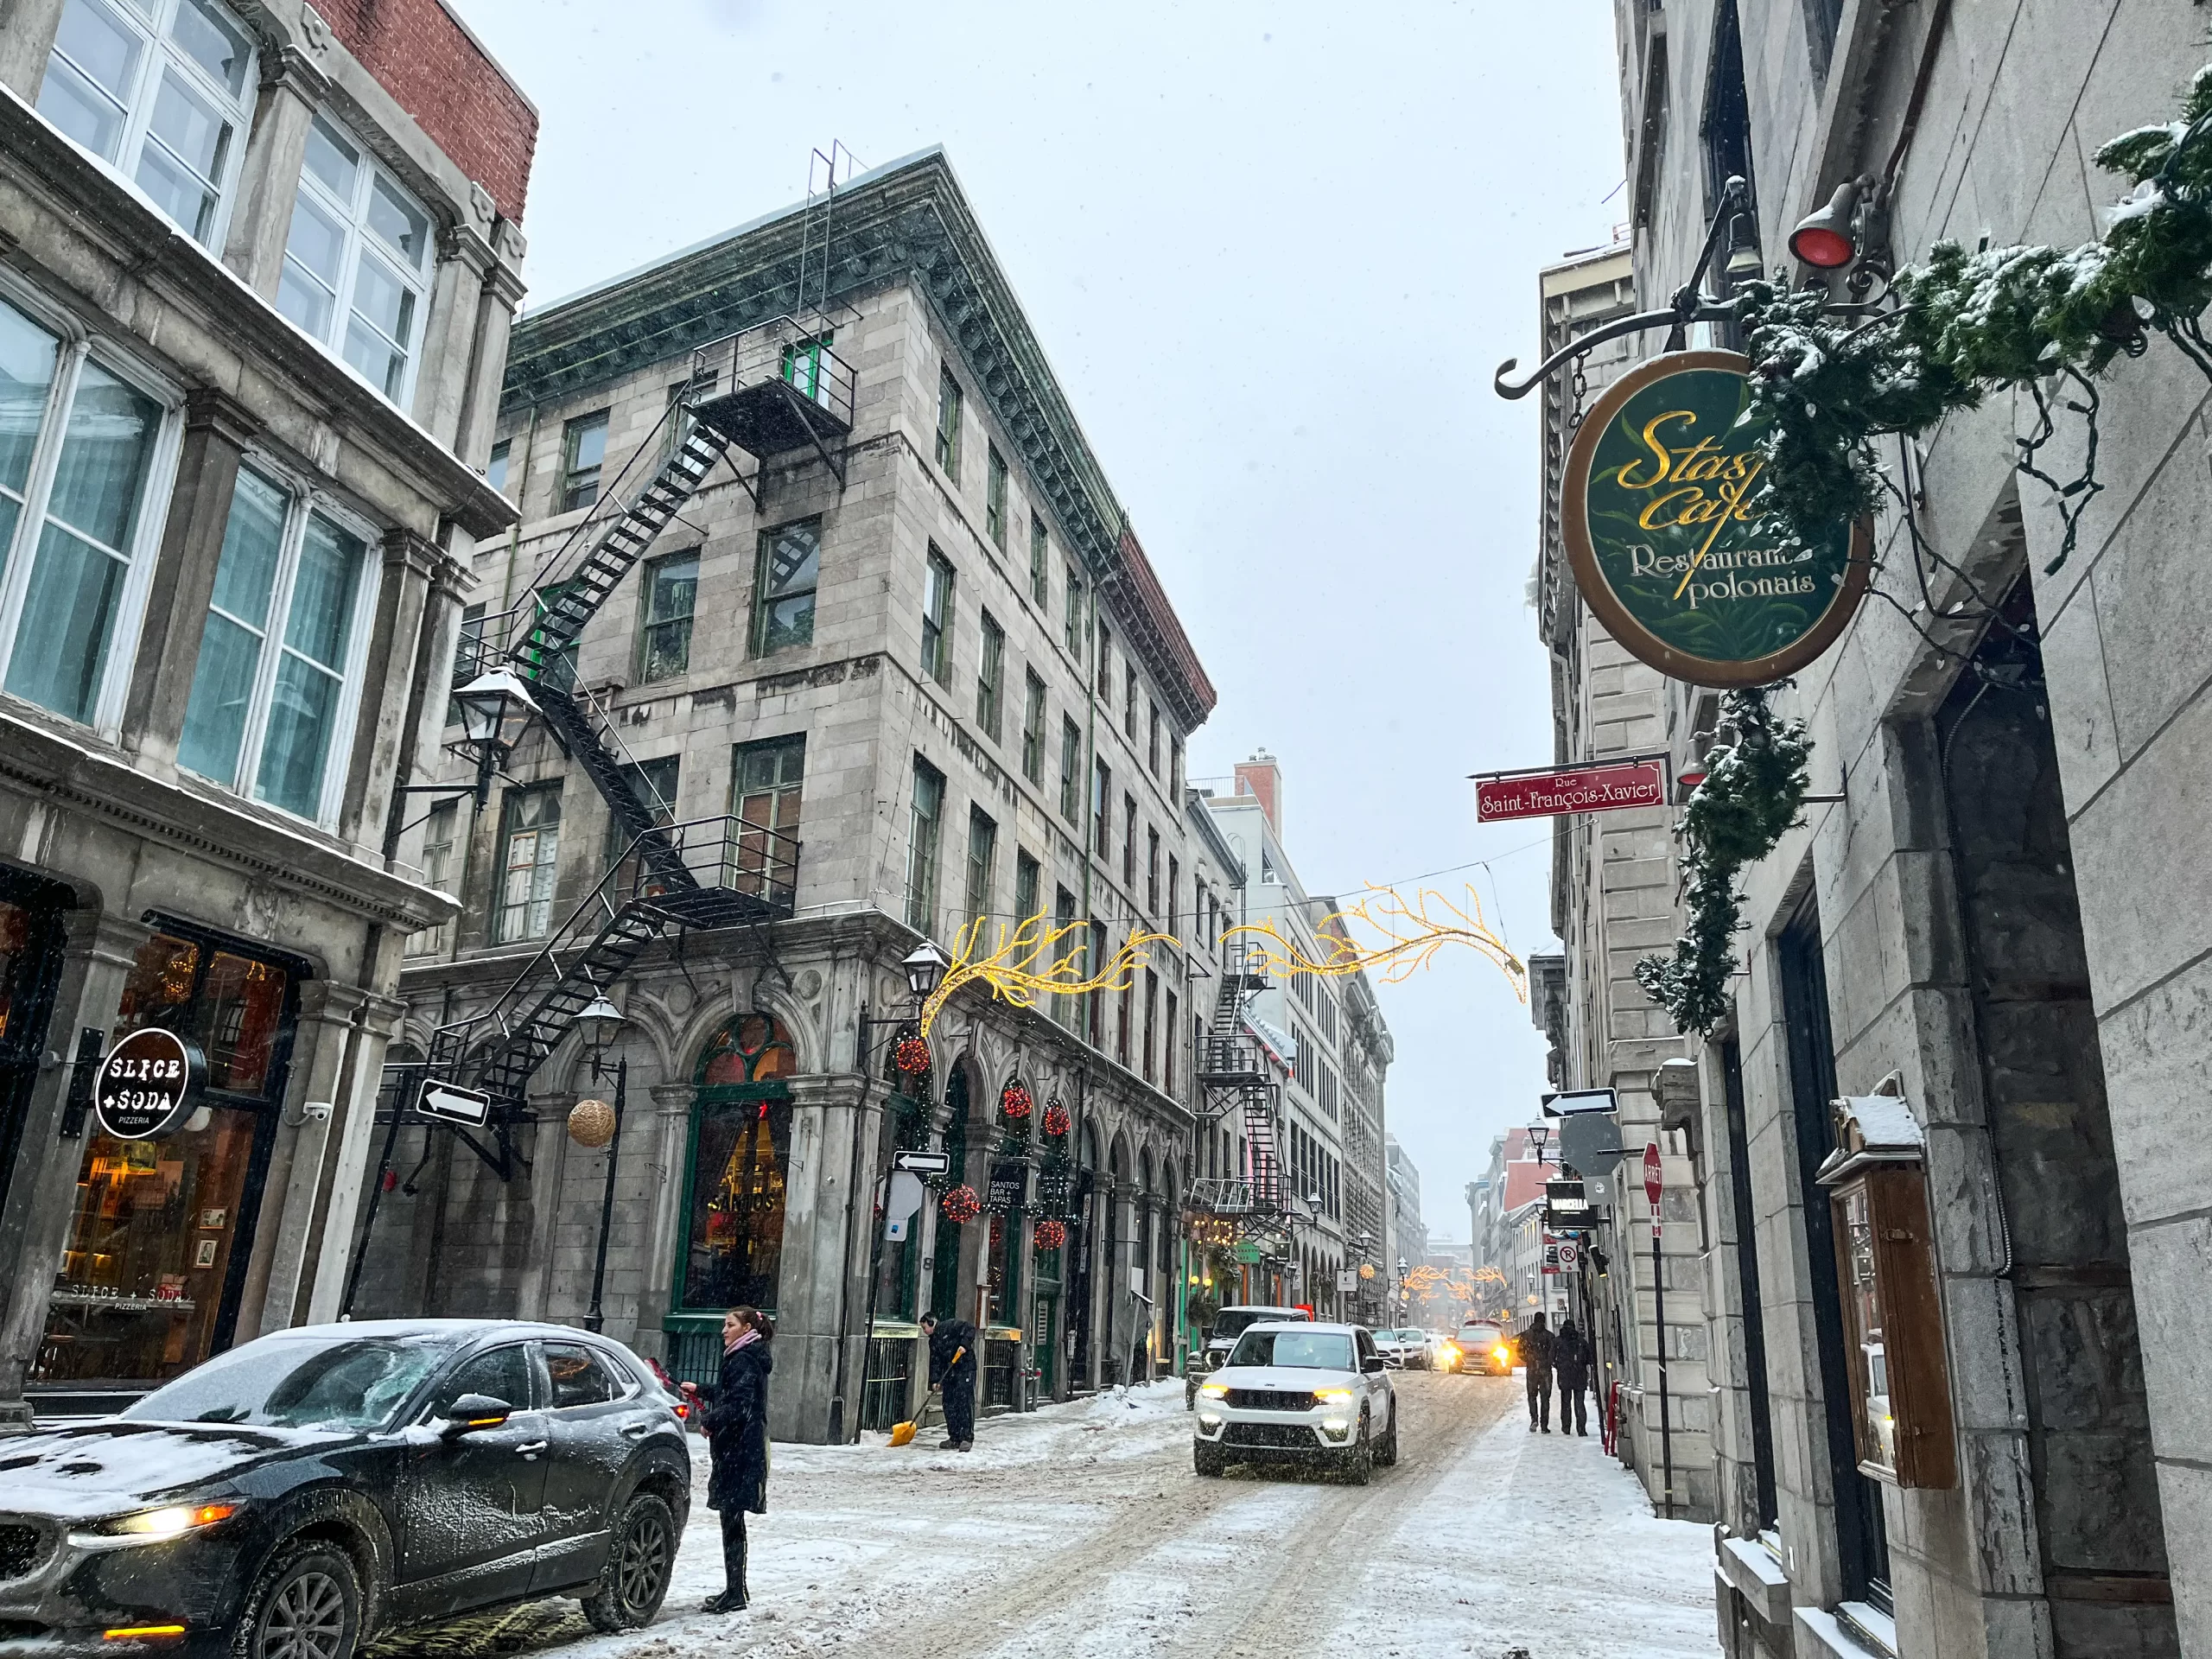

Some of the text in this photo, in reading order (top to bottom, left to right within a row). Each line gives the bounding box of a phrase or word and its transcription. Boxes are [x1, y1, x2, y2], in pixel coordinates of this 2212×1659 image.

[1618, 410, 1764, 489] Stas
[1688, 570, 1815, 610] polonais
[1554, 778, 1578, 788] Rue
[1481, 780, 1656, 814] Saint-François-Xavier
[110, 1057, 181, 1080] SLICE
[118, 1116, 149, 1124] PIZZERIA
[1644, 1163, 1662, 1184] ARRÊT
[990, 1180, 1020, 1190] SANTOS
[989, 1195, 1012, 1205] TAPAS
[71, 1284, 119, 1301] SLICE
[148, 1288, 184, 1303] SODA
[114, 1302, 147, 1311] PIZZERIA
